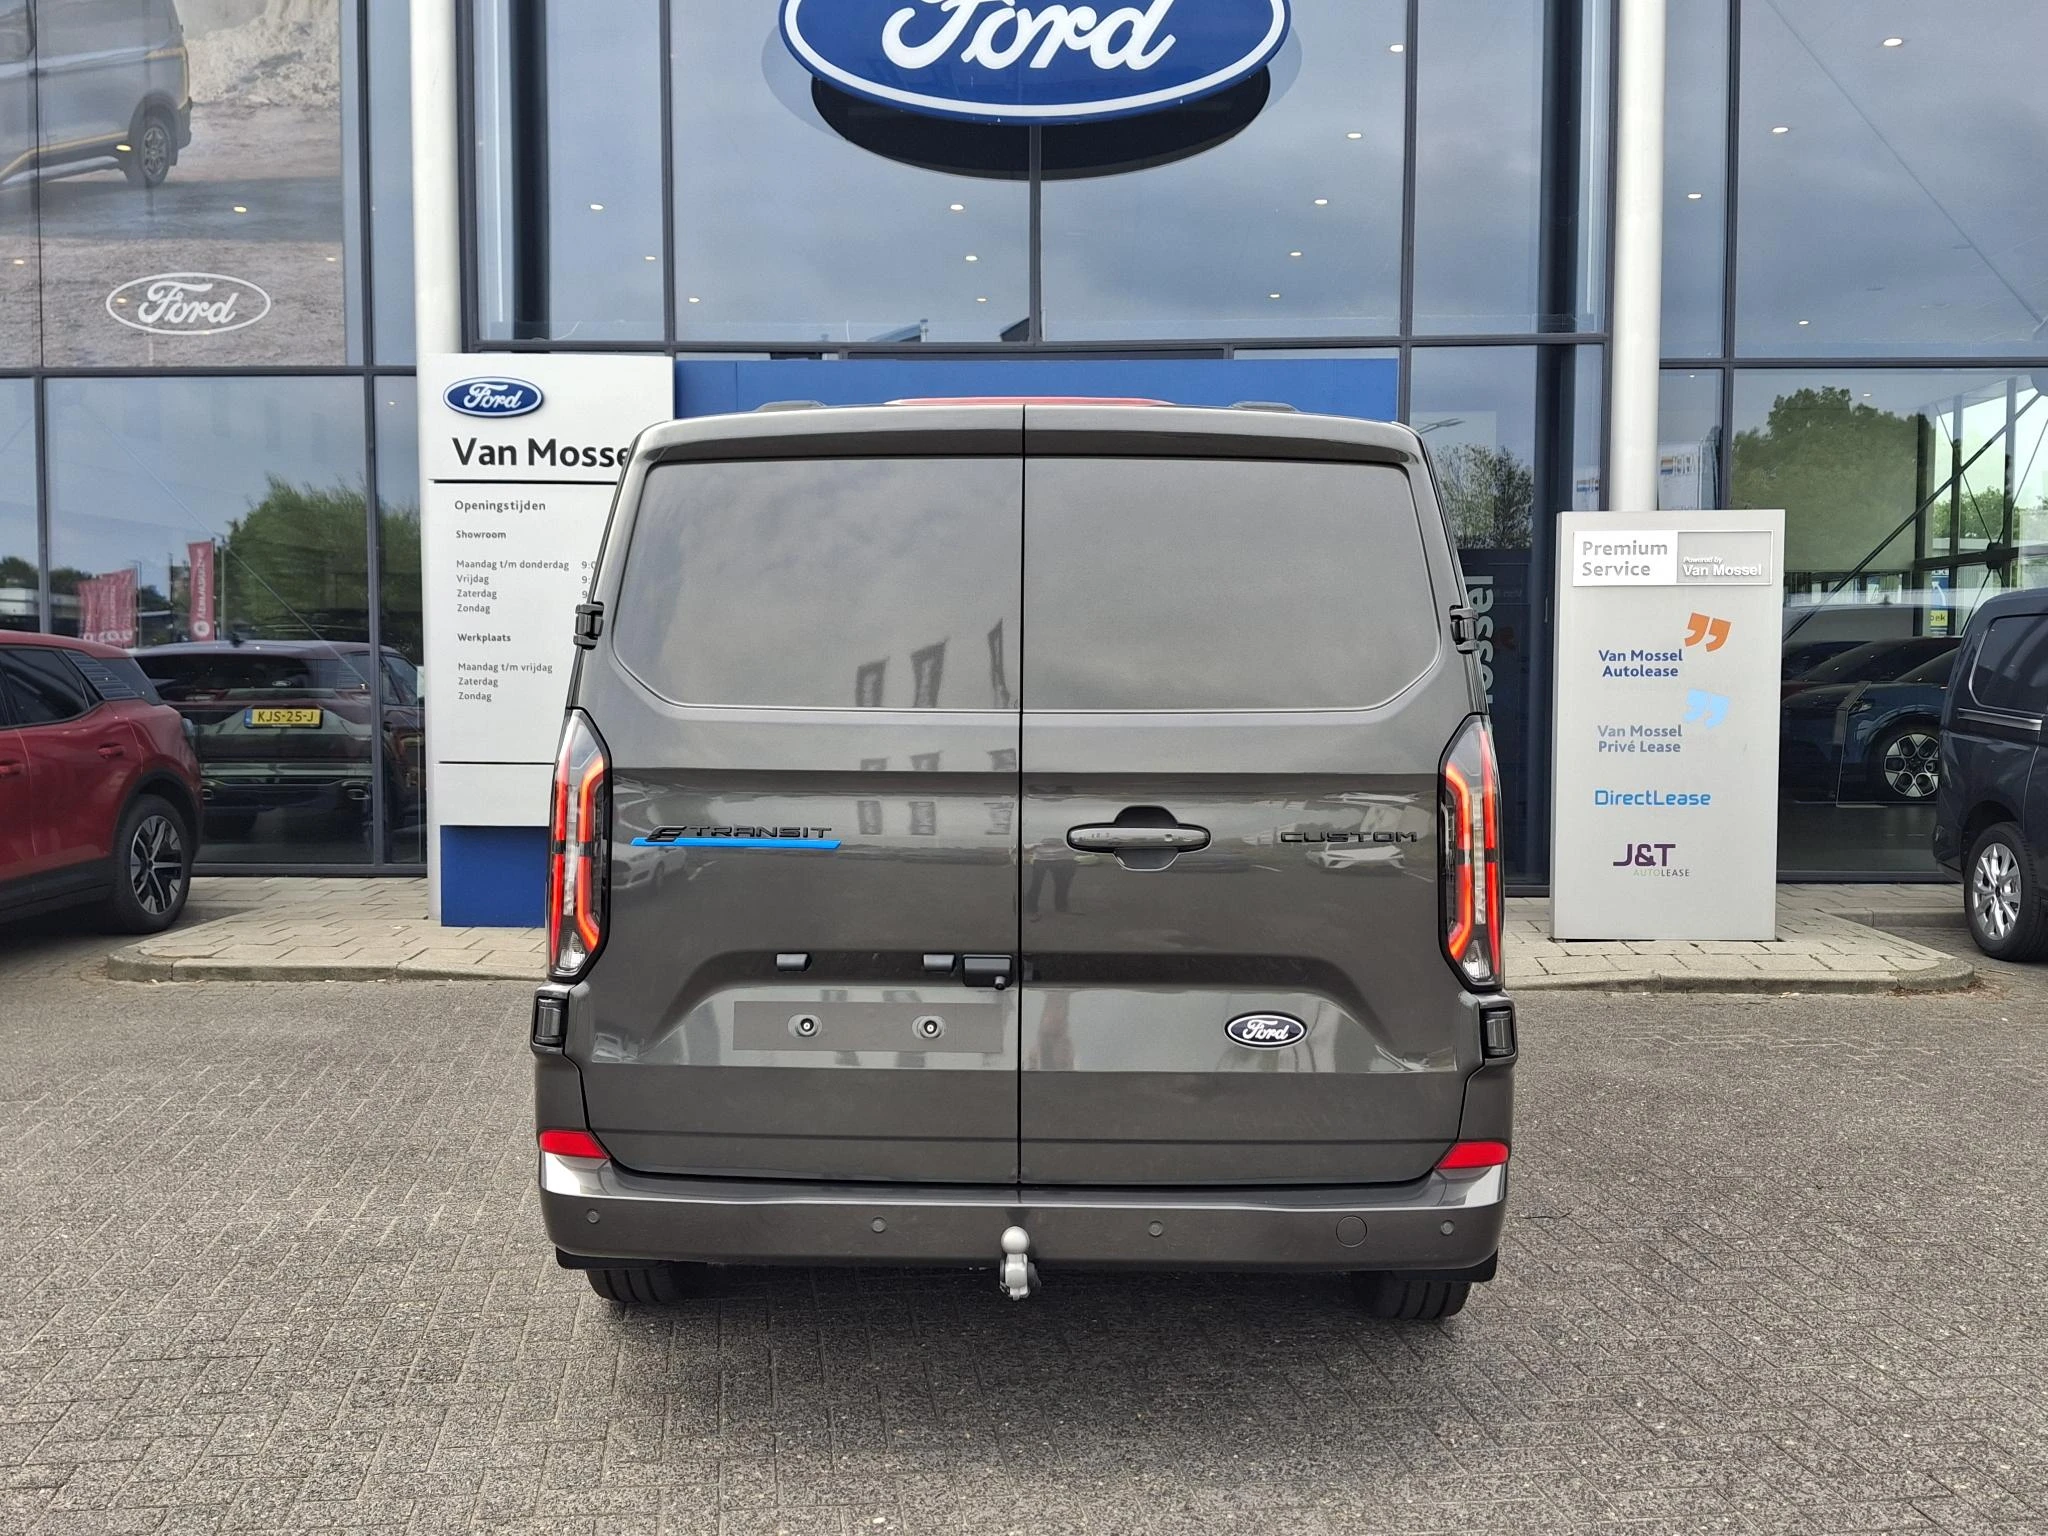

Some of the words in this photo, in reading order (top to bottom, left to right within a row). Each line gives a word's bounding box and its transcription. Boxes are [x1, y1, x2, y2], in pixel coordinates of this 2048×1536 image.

[137, 281, 239, 323] Ford
[463, 383, 523, 409] Ford
[452, 437, 517, 466] Van
[454, 500, 546, 513] Openingstijden
[456, 530, 507, 539] Showroom
[1582, 540, 1668, 556] Premium
[456, 560, 498, 571] Maandag
[500, 560, 517, 569] t/m
[519, 560, 569, 571] donderdag
[1582, 561, 1651, 577] Service
[1682, 564, 1709, 576] Van
[1712, 563, 1762, 576] Mossel
[456, 574, 490, 585] Vrijdag
[457, 589, 498, 600] Zaterdag
[457, 603, 491, 614] Zondag
[457, 633, 511, 643] Werkplaats
[1598, 650, 1626, 662] Van
[1630, 649, 1683, 662] Mossel
[458, 663, 499, 673] Maandag
[501, 663, 518, 672] t/m
[521, 663, 553, 674] vrijdag
[1602, 665, 1679, 677] Autolease
[458, 677, 499, 688] Zaterdag
[458, 691, 492, 702] Zondag
[257, 711, 314, 722] KJS-25-J
[1597, 725, 1625, 737] Van
[1630, 724, 1682, 737] Mossel
[1598, 740, 1635, 752] Privé
[1640, 741, 1681, 752] Lease
[1594, 789, 1711, 805] DirectLease
[1280, 831, 1417, 843] CUSTOM
[1613, 843, 1676, 867] J&T
[1633, 868, 1690, 877] AUTOLEASE
[1242, 1019, 1290, 1040] Ford
